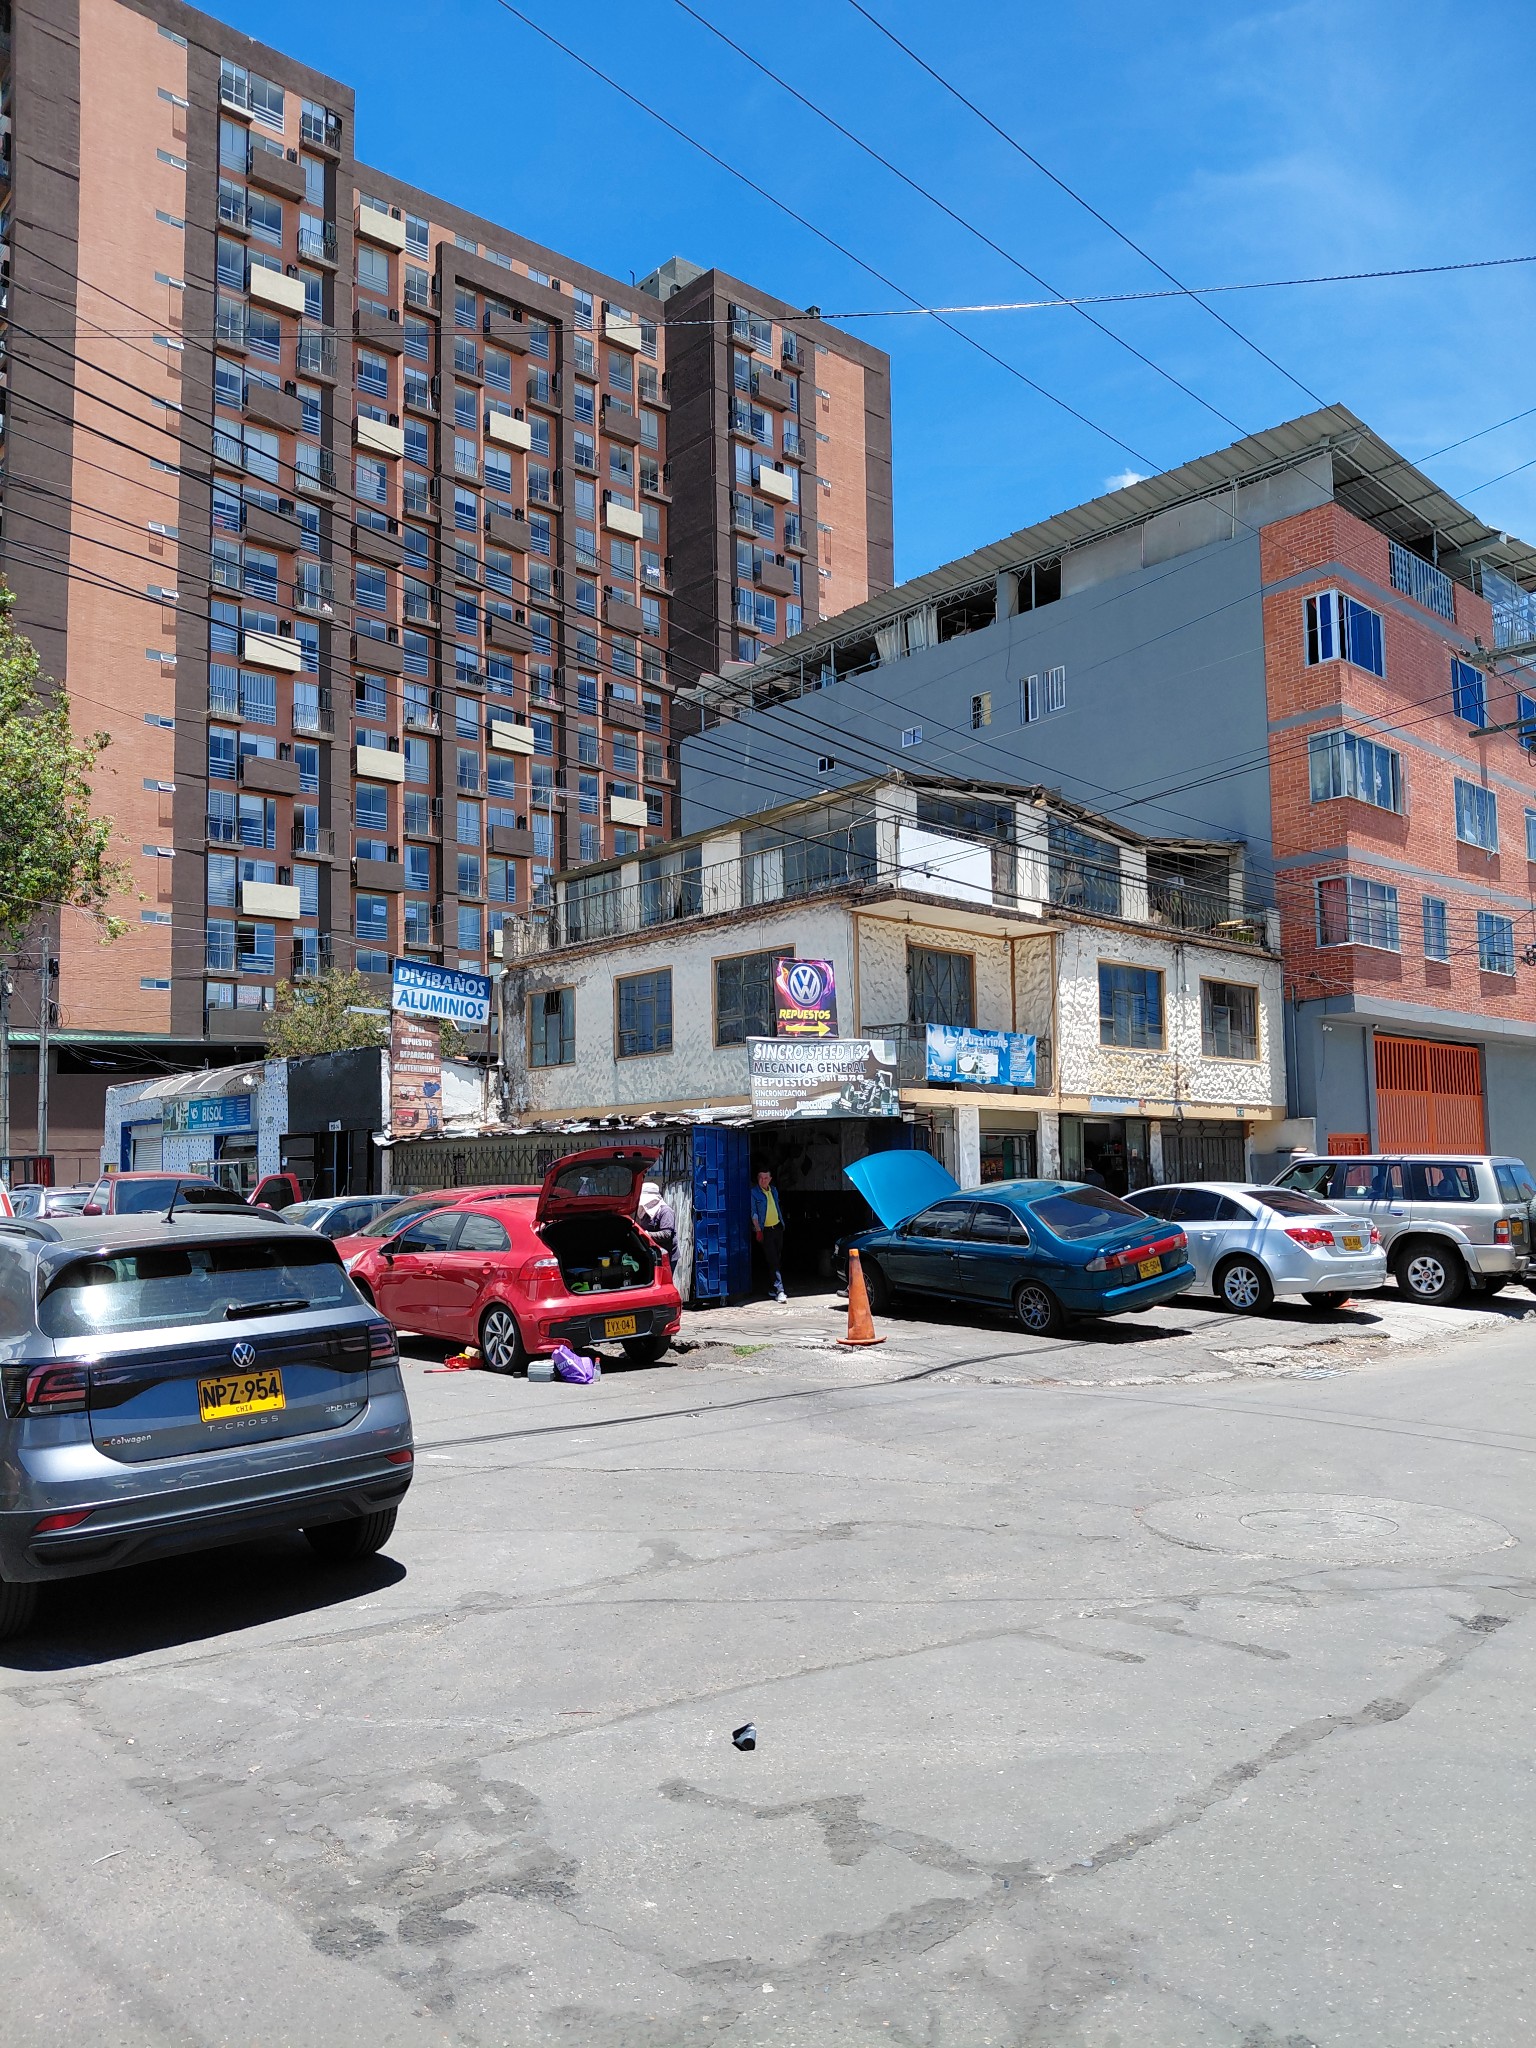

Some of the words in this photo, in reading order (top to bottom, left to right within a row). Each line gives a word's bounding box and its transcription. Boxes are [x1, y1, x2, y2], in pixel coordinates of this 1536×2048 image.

[398, 966, 486, 997] DIVIBAÑOS
[397, 990, 485, 1019] ALUMINIOS
[779, 1009, 831, 1021] REPUESTOS
[401, 1037, 433, 1047] REPUESTOS
[753, 1043, 804, 1061] SINCRO
[805, 1044, 846, 1061] SPEED
[849, 1044, 871, 1060] 132
[394, 1063, 440, 1073] MANTENIMIENTO
[753, 1062, 814, 1073] MECANICA
[817, 1062, 866, 1073] GENERAL
[754, 1077, 819, 1087] REPUESTOS
[755, 1099, 780, 1107] FRENOS
[202, 1105, 223, 1122] BISOL
[756, 1107, 795, 1117] SUSPENSIÓN
[236, 1404, 253, 1413] CHIA
[325, 1404, 343, 1413] 200
[344, 1401, 358, 1410] TSI
[207, 1415, 280, 1432] T-CROSS
[110, 1434, 152, 1446] Colwagen
